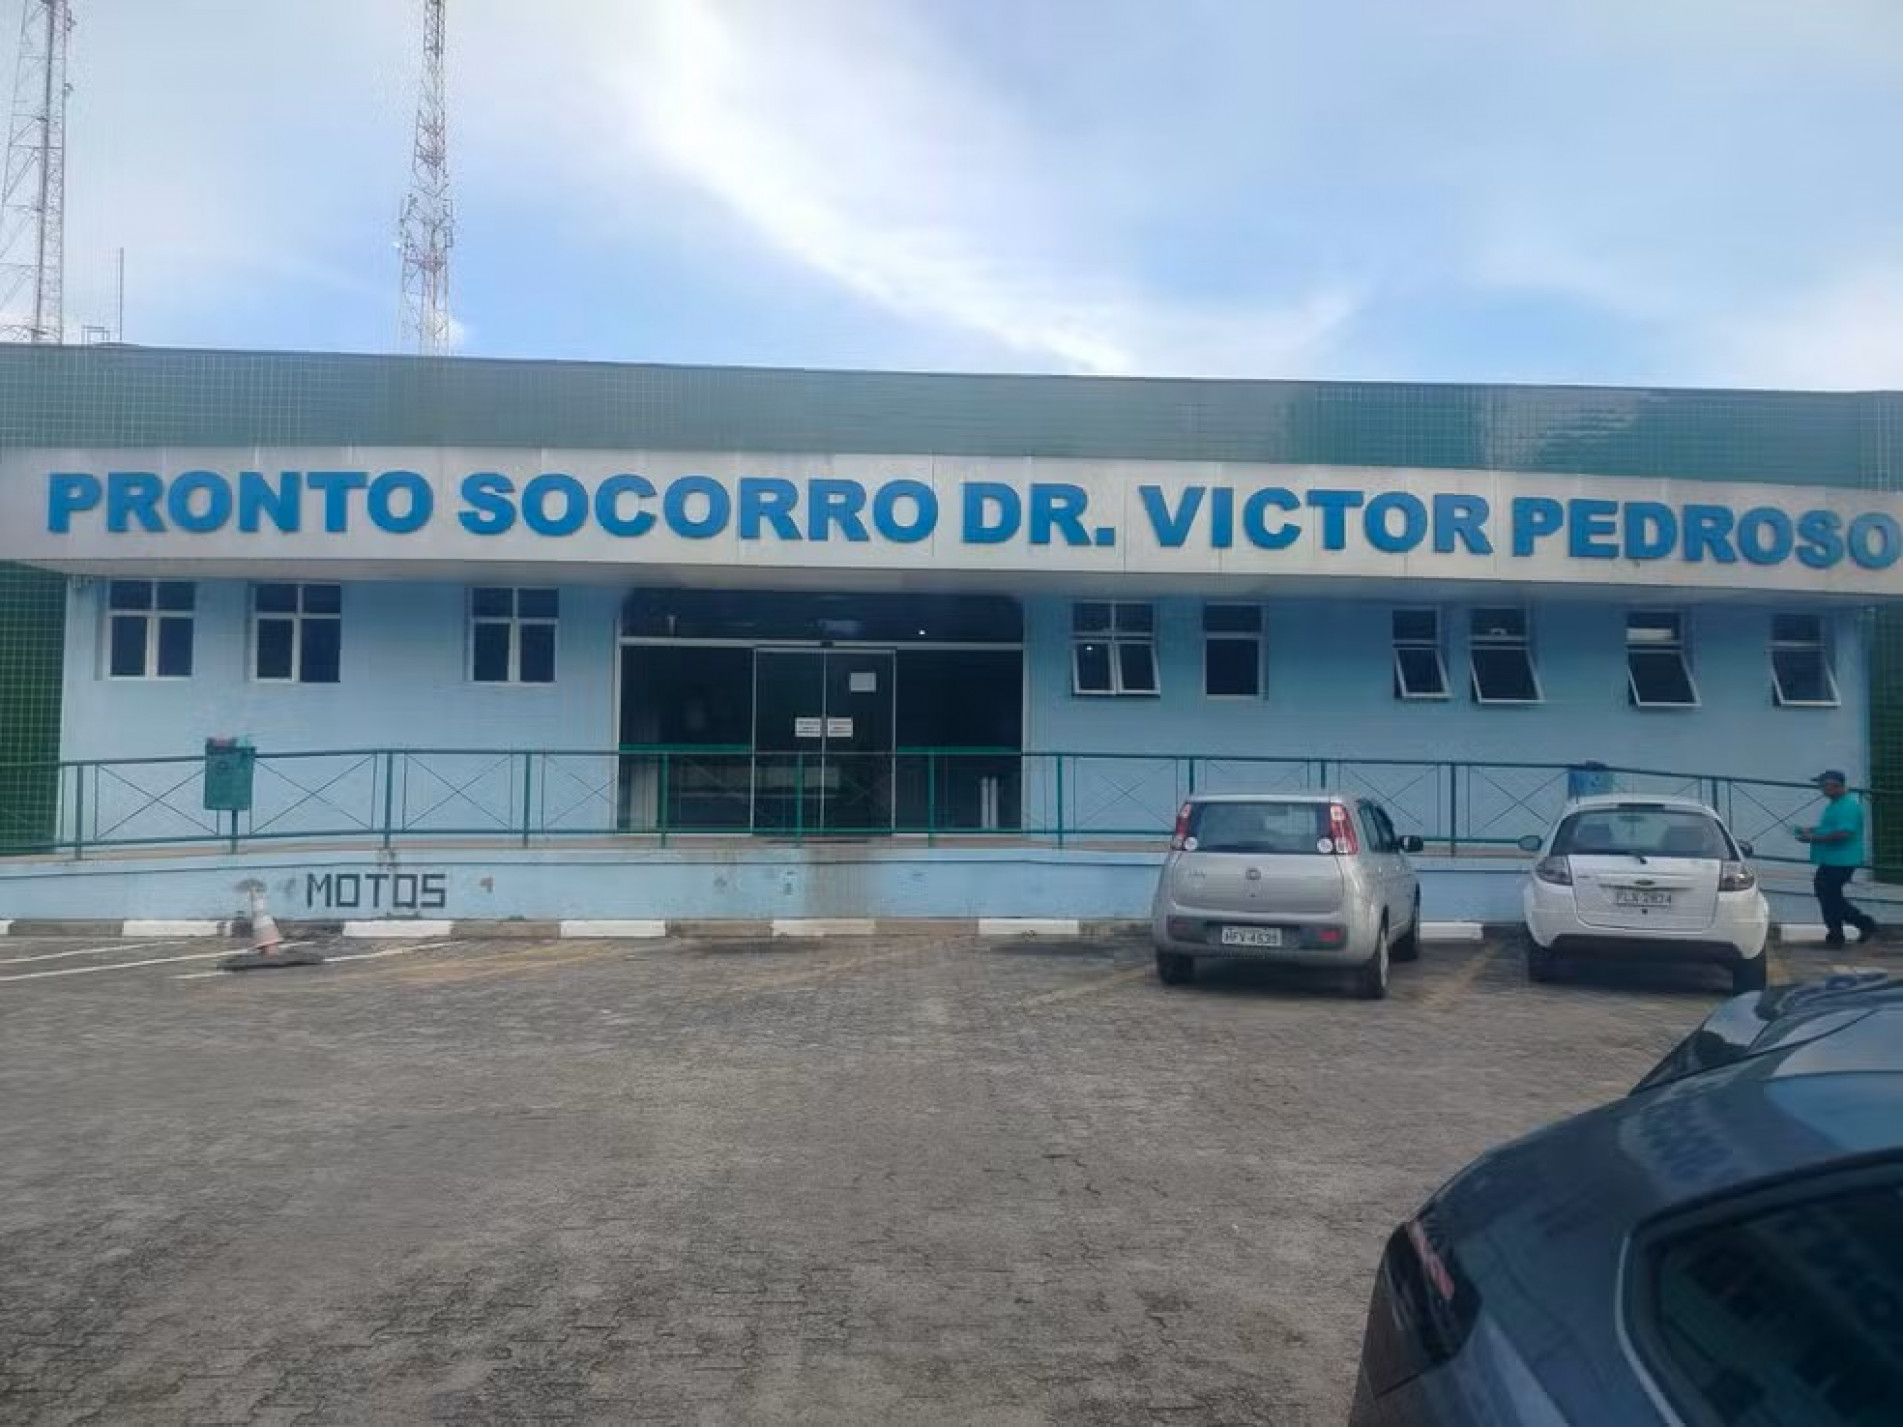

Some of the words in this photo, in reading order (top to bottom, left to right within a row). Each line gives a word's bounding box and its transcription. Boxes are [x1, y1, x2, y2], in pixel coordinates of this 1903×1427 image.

[46, 470, 433, 535] PRONTO
[457, 472, 939, 542] SOCORRO
[961, 482, 1115, 546] DR.
[1140, 487, 1491, 555] VICTOR
[1512, 497, 1901, 569] PEDROSO
[306, 873, 447, 908] MOTOS
